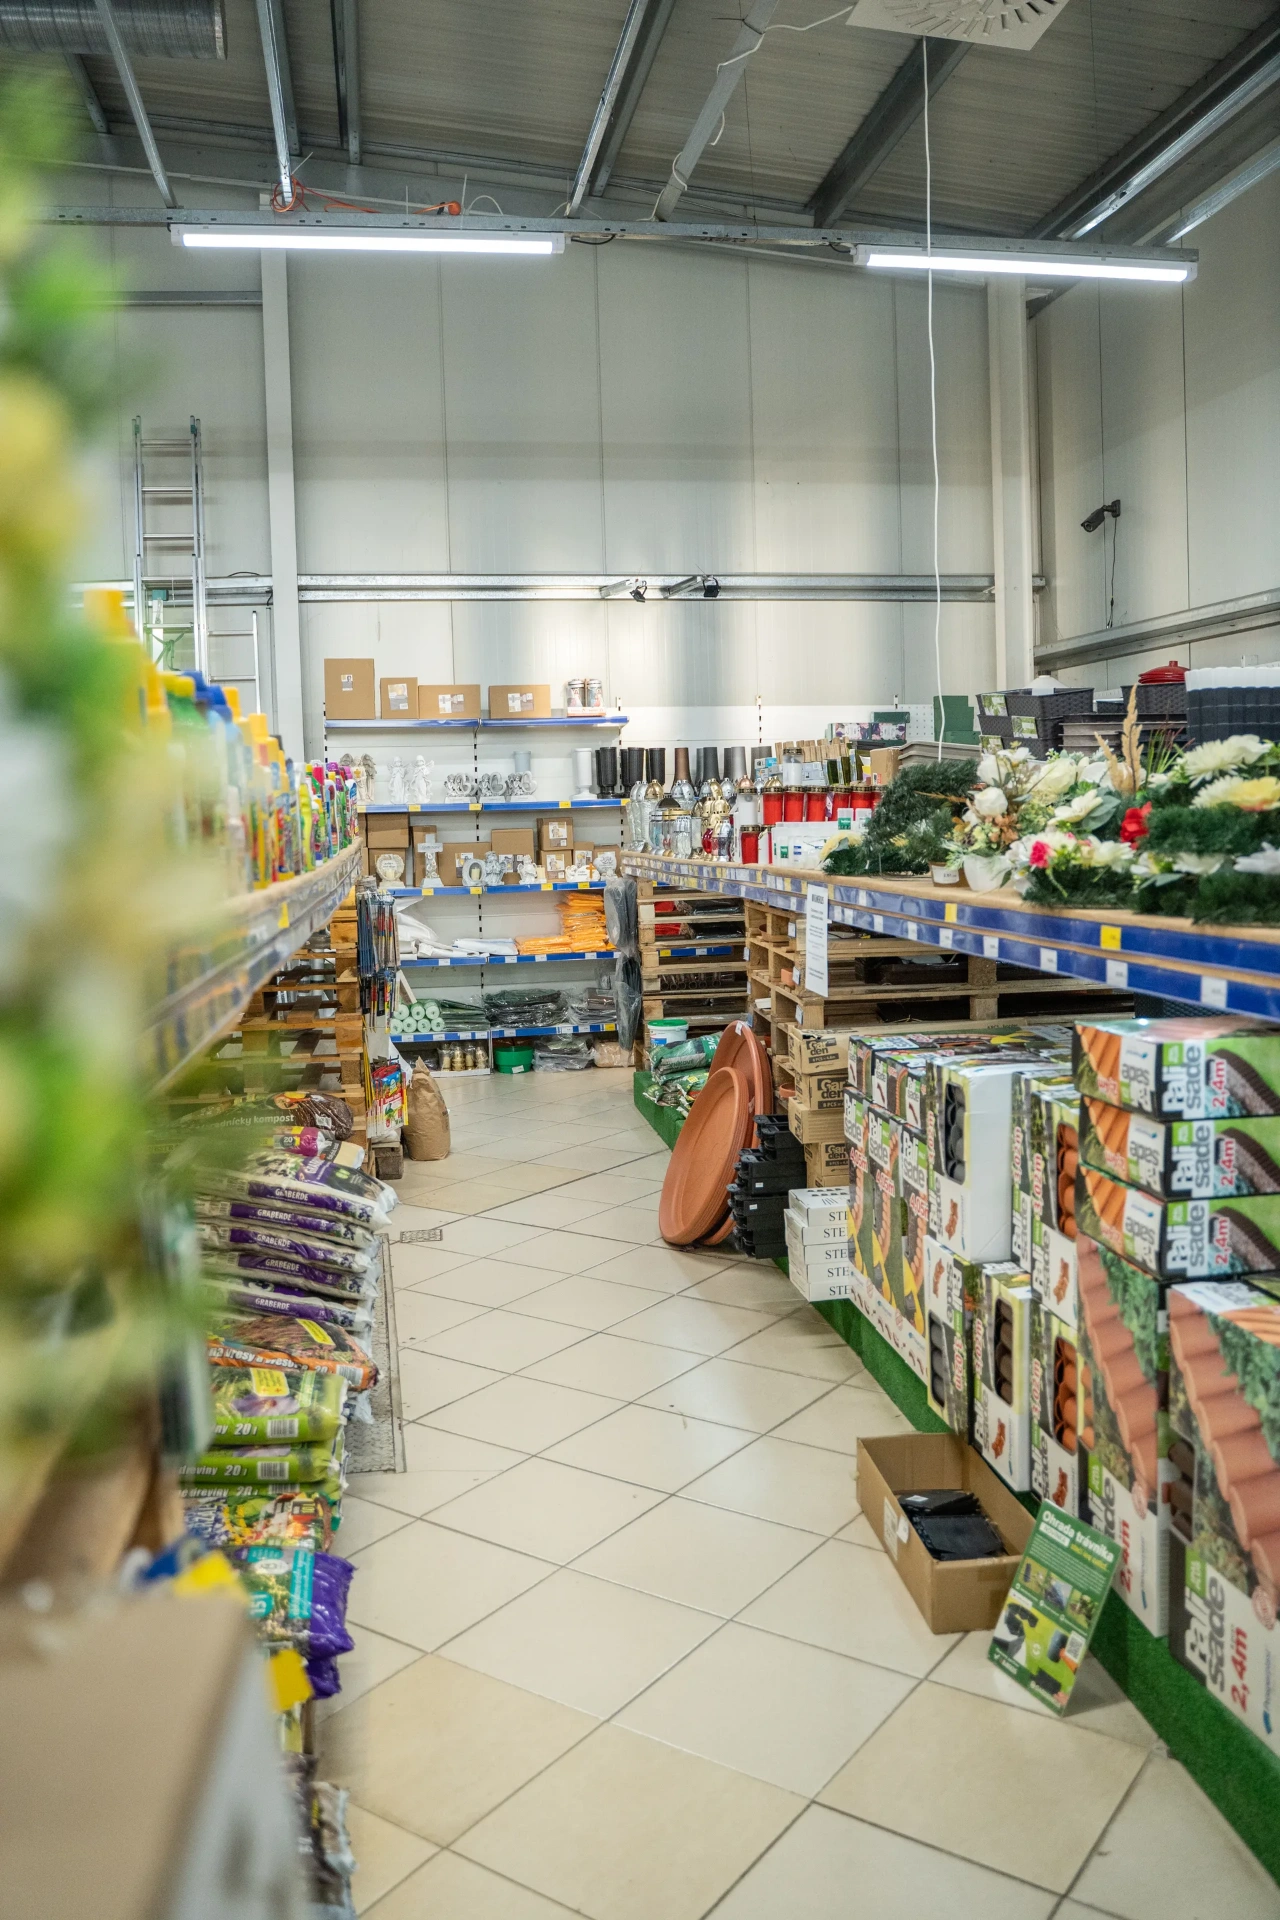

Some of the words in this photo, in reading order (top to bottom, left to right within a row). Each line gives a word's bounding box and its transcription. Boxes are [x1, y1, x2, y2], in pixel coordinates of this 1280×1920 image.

[821, 1079, 845, 1089] Gar
[1186, 1045, 1202, 1110] sade
[1211, 1060, 1226, 1108] 2,4m
[253, 1114, 295, 1124] kompost
[869, 1137, 888, 1165] sade
[1195, 1123, 1211, 1189] sade
[1220, 1139, 1235, 1187] 2,4m
[903, 1158, 925, 1189] sade
[1171, 1145, 1195, 1191] Pali
[275, 1188, 309, 1201] GRABERDE
[257, 1208, 292, 1221] GRABERDE
[256, 1234, 292, 1248] GRABERDE
[1167, 1224, 1190, 1270] Pali
[1190, 1204, 1205, 1267] sade
[1215, 1218, 1230, 1265] 2,4m
[265, 1258, 300, 1272] GRABERDE
[255, 1297, 290, 1311] GRABERDE
[225, 1348, 255, 1362] vresy
[234, 1423, 251, 1435] 20
[224, 1464, 242, 1476] 20
[236, 1486, 251, 1496] 20
[1042, 1510, 1075, 1537] Ohrada
[1075, 1530, 1114, 1563] trávnika
[1185, 1586, 1207, 1664] Pali
[1208, 1576, 1225, 1693] sade
[1231, 1626, 1248, 1713] 2,4m
